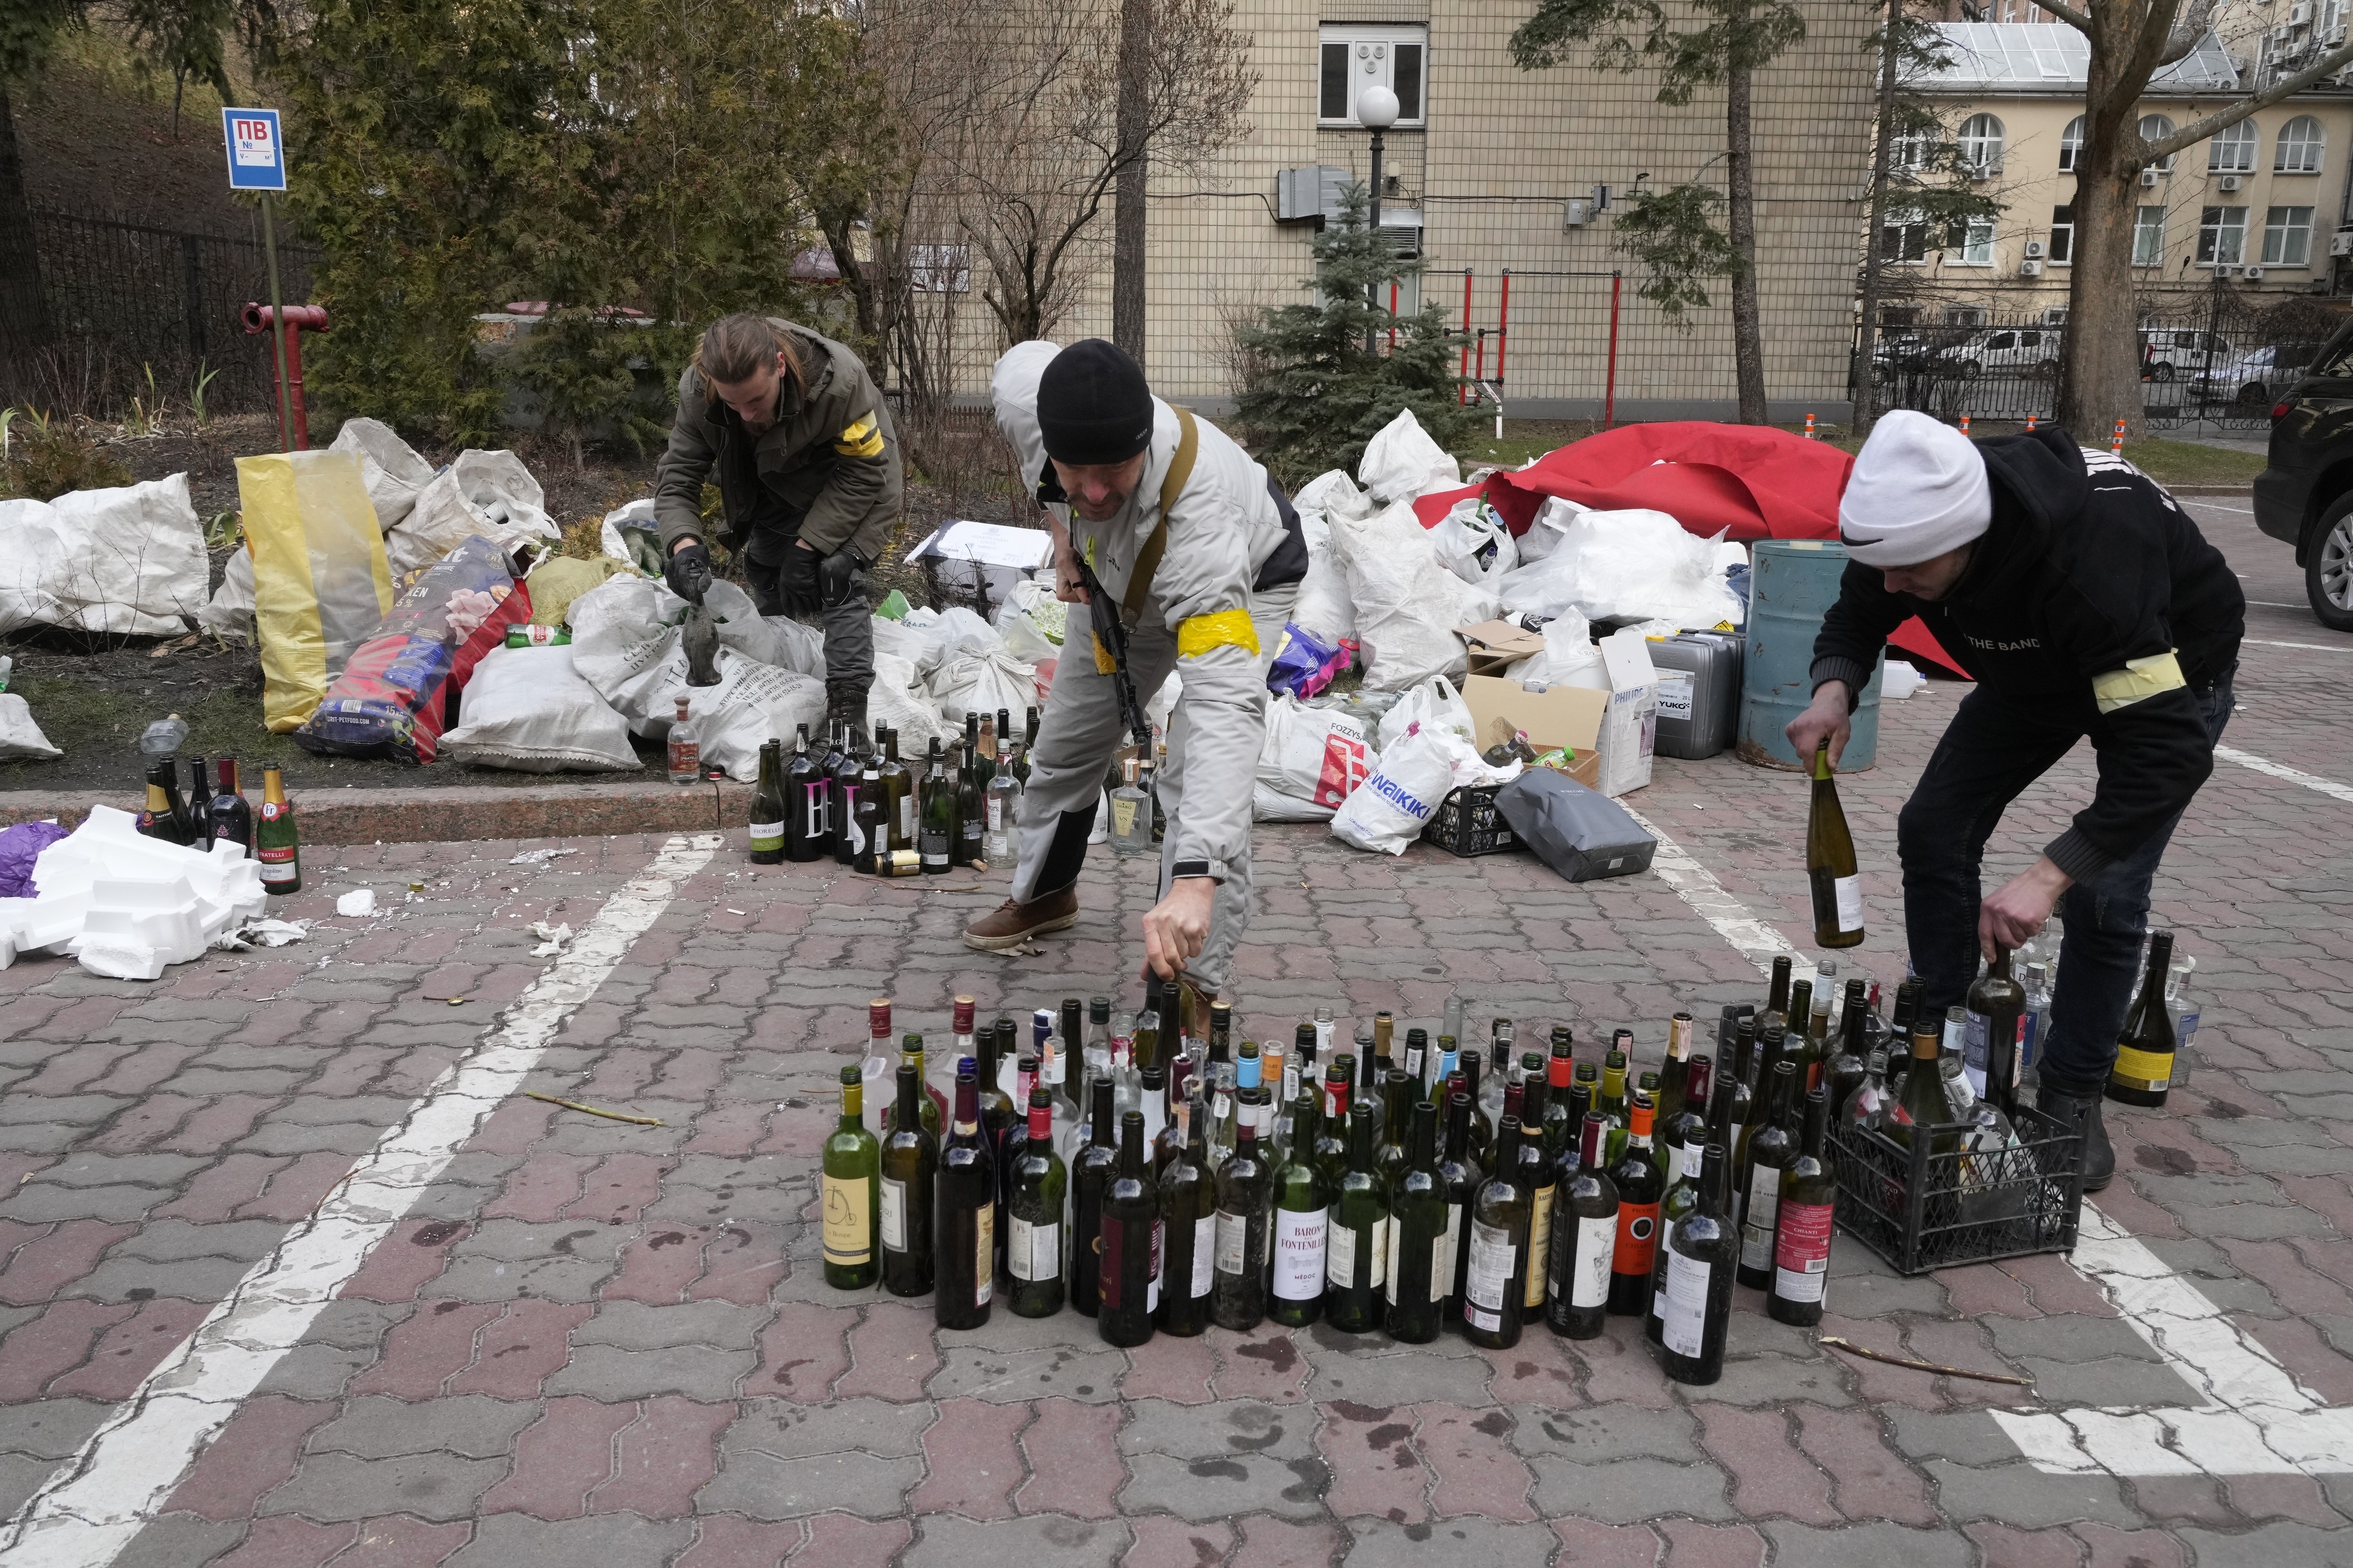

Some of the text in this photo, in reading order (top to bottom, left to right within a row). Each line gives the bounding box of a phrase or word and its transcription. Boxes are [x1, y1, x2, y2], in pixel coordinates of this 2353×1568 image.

[237, 120, 267, 140] ПВ
[1968, 636, 2040, 651] THE BAND
[758, 677, 775, 692] (04735)
[764, 684, 782, 697] (04735)
[771, 693, 784, 703] (044)
[1659, 701, 1689, 710] YUKO
[1371, 788, 1386, 802] deserves
[1389, 802, 1401, 813] dress
[1400, 809, 1410, 818] well
[266, 805, 274, 815] Fr
[1295, 1225, 1321, 1237] BARON
[1281, 1235, 1327, 1250] FONTENILLES
[1673, 1260, 1691, 1270] PURCARI
